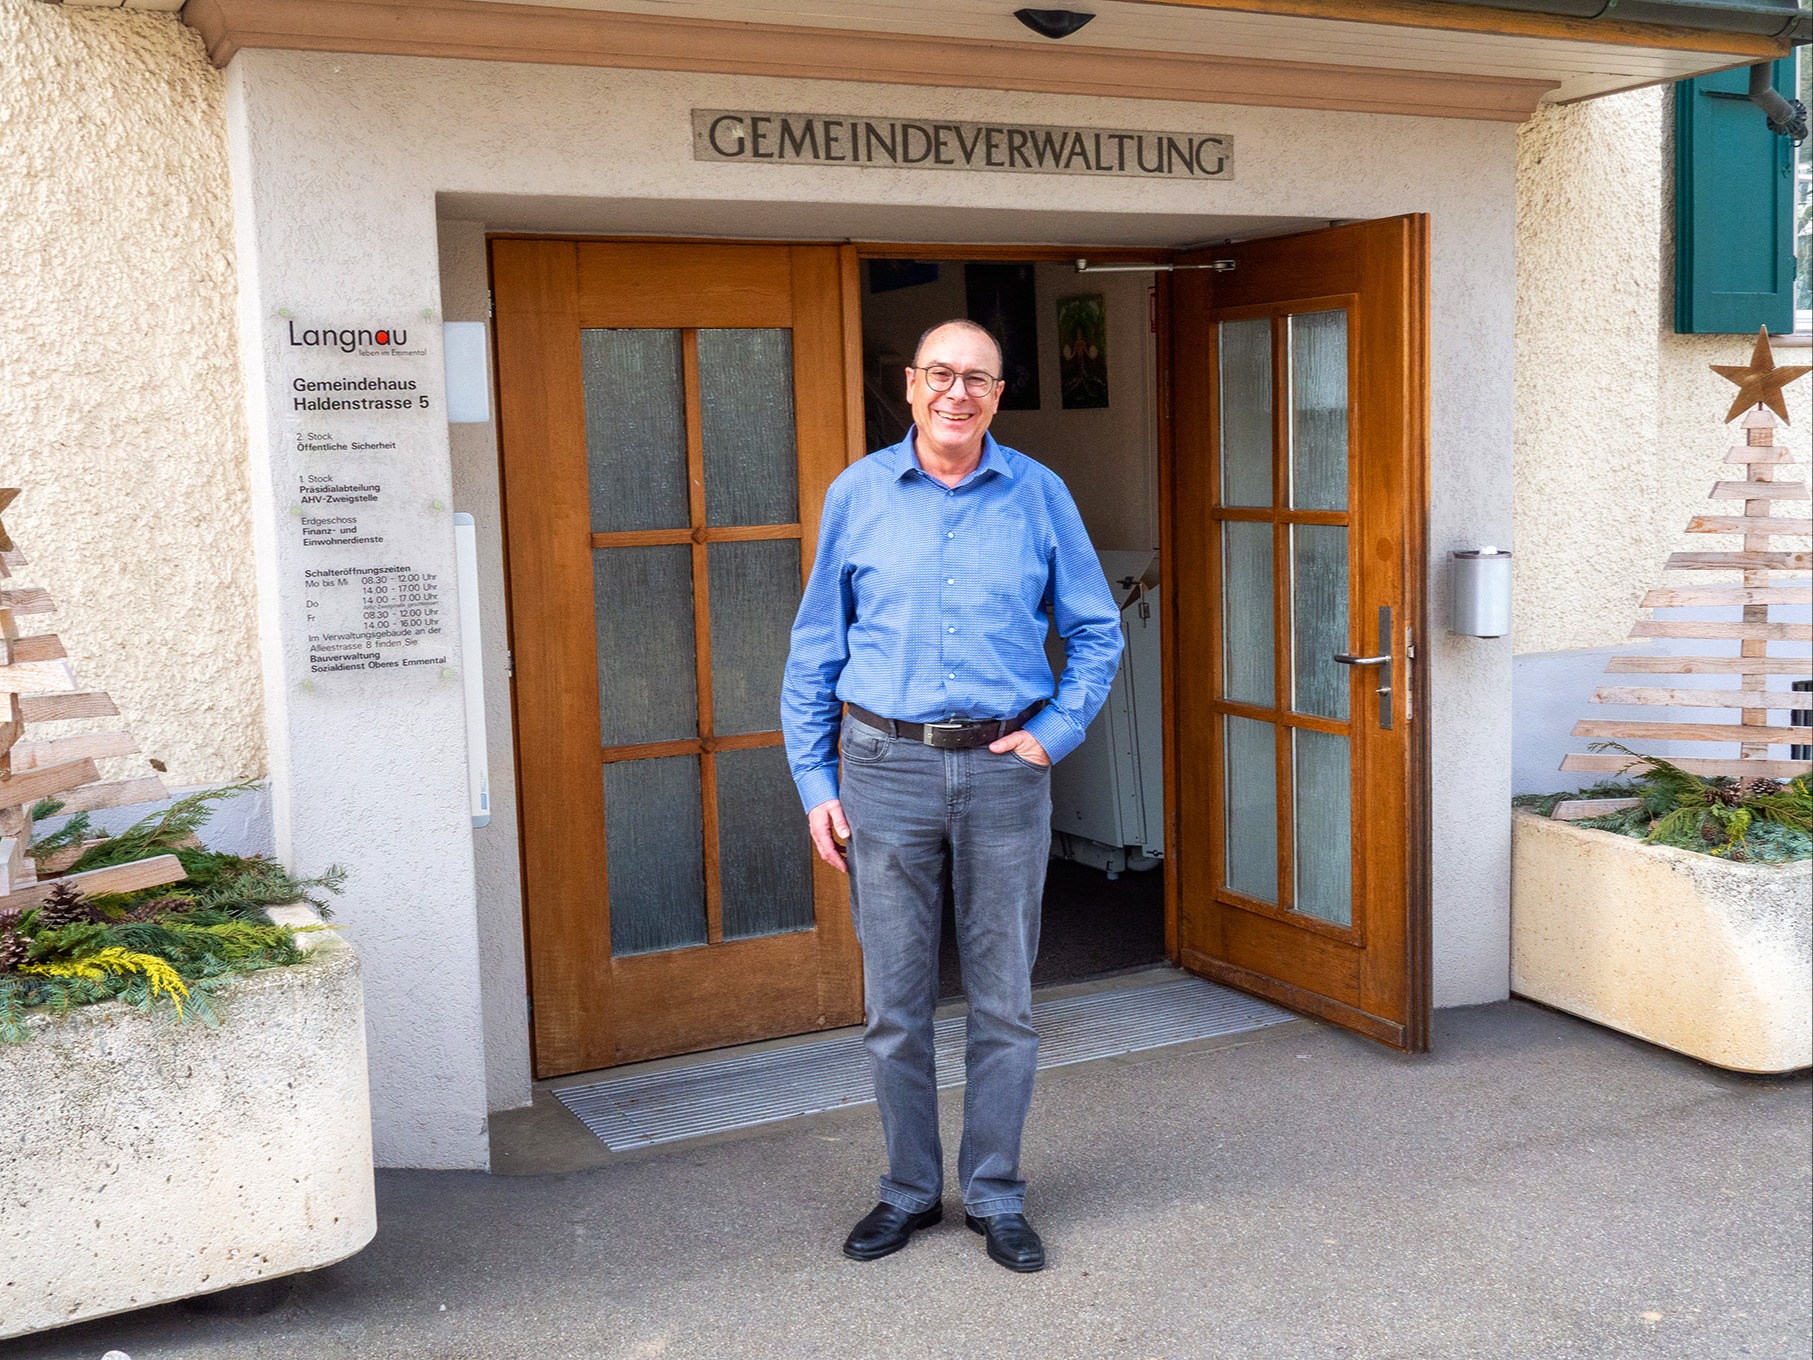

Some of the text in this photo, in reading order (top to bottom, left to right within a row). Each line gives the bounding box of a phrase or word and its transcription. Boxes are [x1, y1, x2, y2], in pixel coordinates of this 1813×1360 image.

[708, 114, 1225, 176] GEMEINDEVERWALTUNG
[289, 320, 407, 353] Langnau
[391, 348, 427, 356] Emmental
[293, 377, 417, 392] Gemeindehaus
[294, 395, 430, 411] Haldenstrasse 5
[307, 432, 333, 441] Stock
[297, 441, 396, 452] Öffentliche Sicherheit
[308, 475, 333, 483] Stock
[299, 484, 381, 494] Präsidialabteilung
[301, 494, 379, 504] AHV-Zweigstelle
[301, 516, 358, 527] Erdgeschoss
[340, 526, 357, 534] und
[303, 536, 384, 547] Einwohnerdienste
[304, 565, 411, 578] Schalteröffnungszeiten
[305, 580, 320, 588] Mo
[322, 579, 335, 587] bis
[337, 578, 349, 586] Mi
[361, 576, 388, 585] 08.30
[397, 574, 420, 583] 12.00
[422, 573, 437, 582] Uhr
[362, 586, 388, 595] 14.00
[398, 584, 421, 593] 17.00
[423, 583, 438, 592] Uhr
[306, 600, 319, 608] Do
[362, 596, 389, 605] 14.00
[399, 593, 422, 603] 17.00
[423, 593, 438, 601] Uhr
[307, 615, 316, 623] Fr
[363, 611, 389, 620] 08.30
[399, 608, 422, 618] 12.00
[424, 608, 439, 616] Uhr
[363, 621, 390, 630] 14.00
[400, 618, 422, 628] 16.00
[424, 618, 439, 626] Uhr
[415, 628, 426, 636] an
[427, 626, 442, 635] der
[309, 642, 363, 653] Alleestrasse
[365, 641, 372, 649] 8
[375, 639, 402, 649] finden
[310, 652, 381, 663] Bauverwaltung
[310, 656, 447, 673] Sozialdienst Oberes Emmental
